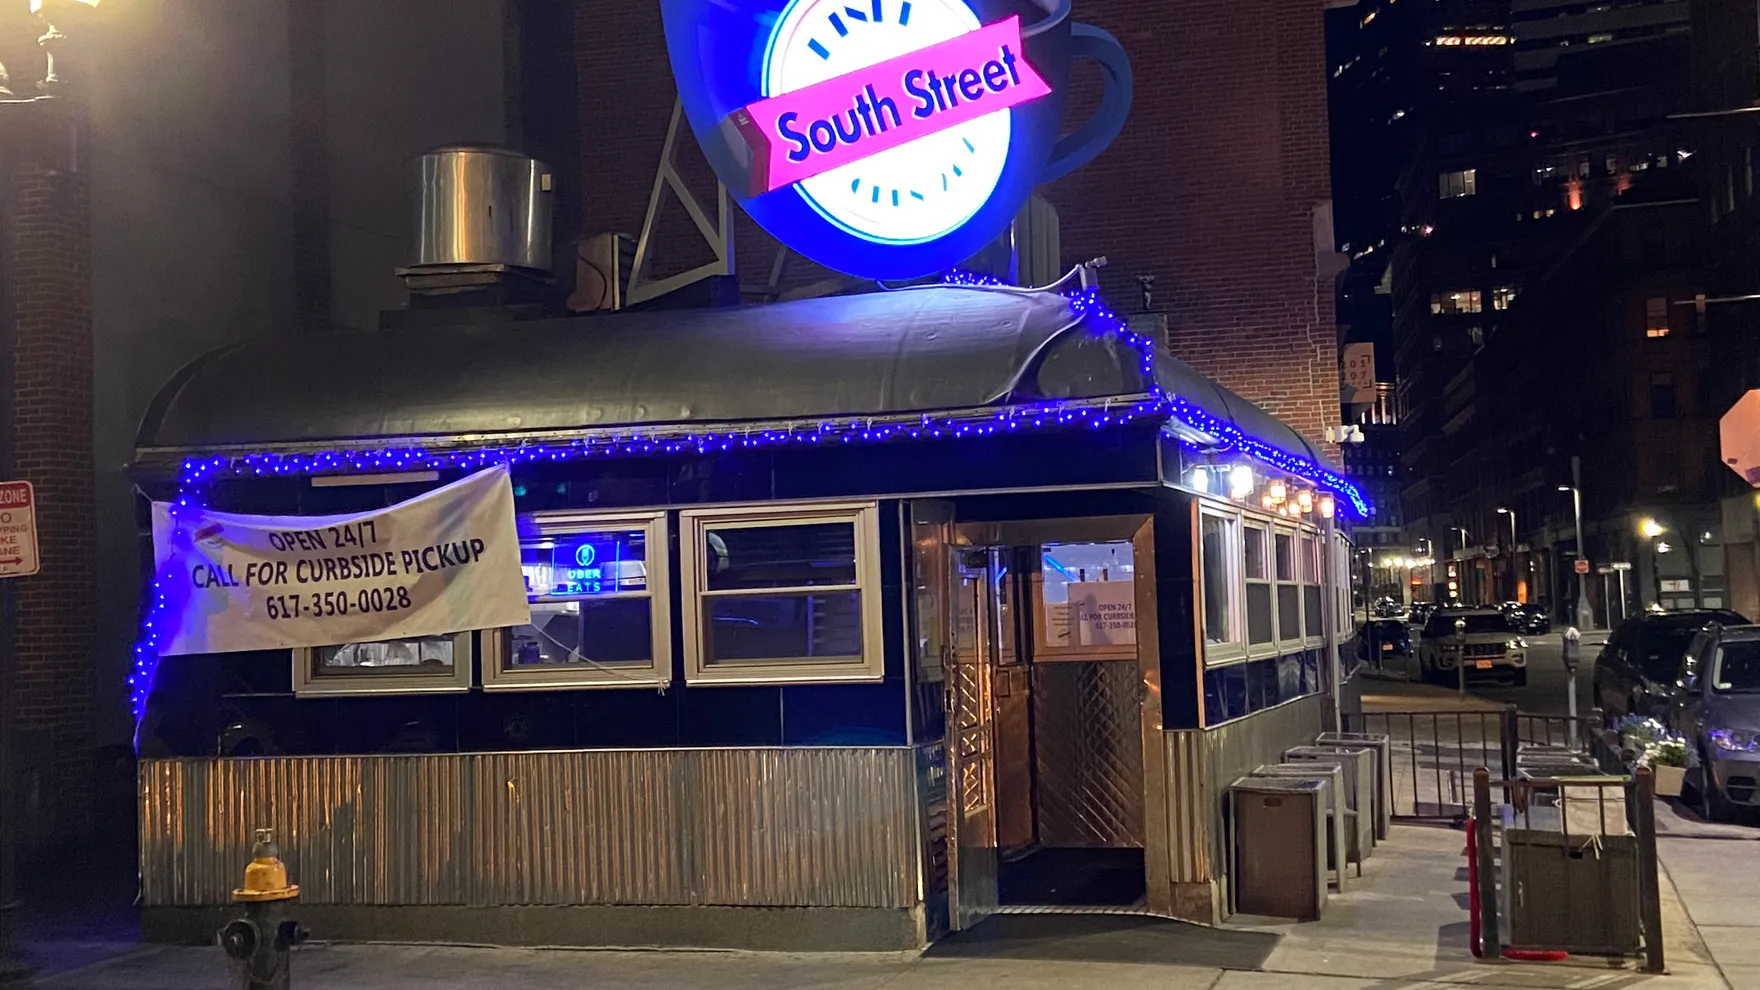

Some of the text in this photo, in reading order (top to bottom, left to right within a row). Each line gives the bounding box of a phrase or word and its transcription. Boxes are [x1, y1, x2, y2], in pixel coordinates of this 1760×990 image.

[778, 44, 1021, 162] South Street
[0, 512, 12, 523] O
[0, 535, 18, 545] KE
[268, 520, 377, 552] OPEN 24/7
[192, 538, 485, 588] CALL FOR CURBSIDE PICKUP
[567, 568, 601, 579] UBER
[567, 582, 601, 593] EATS
[266, 586, 411, 619] 617-350-0028
[1095, 621, 1134, 629] 617-350-002
